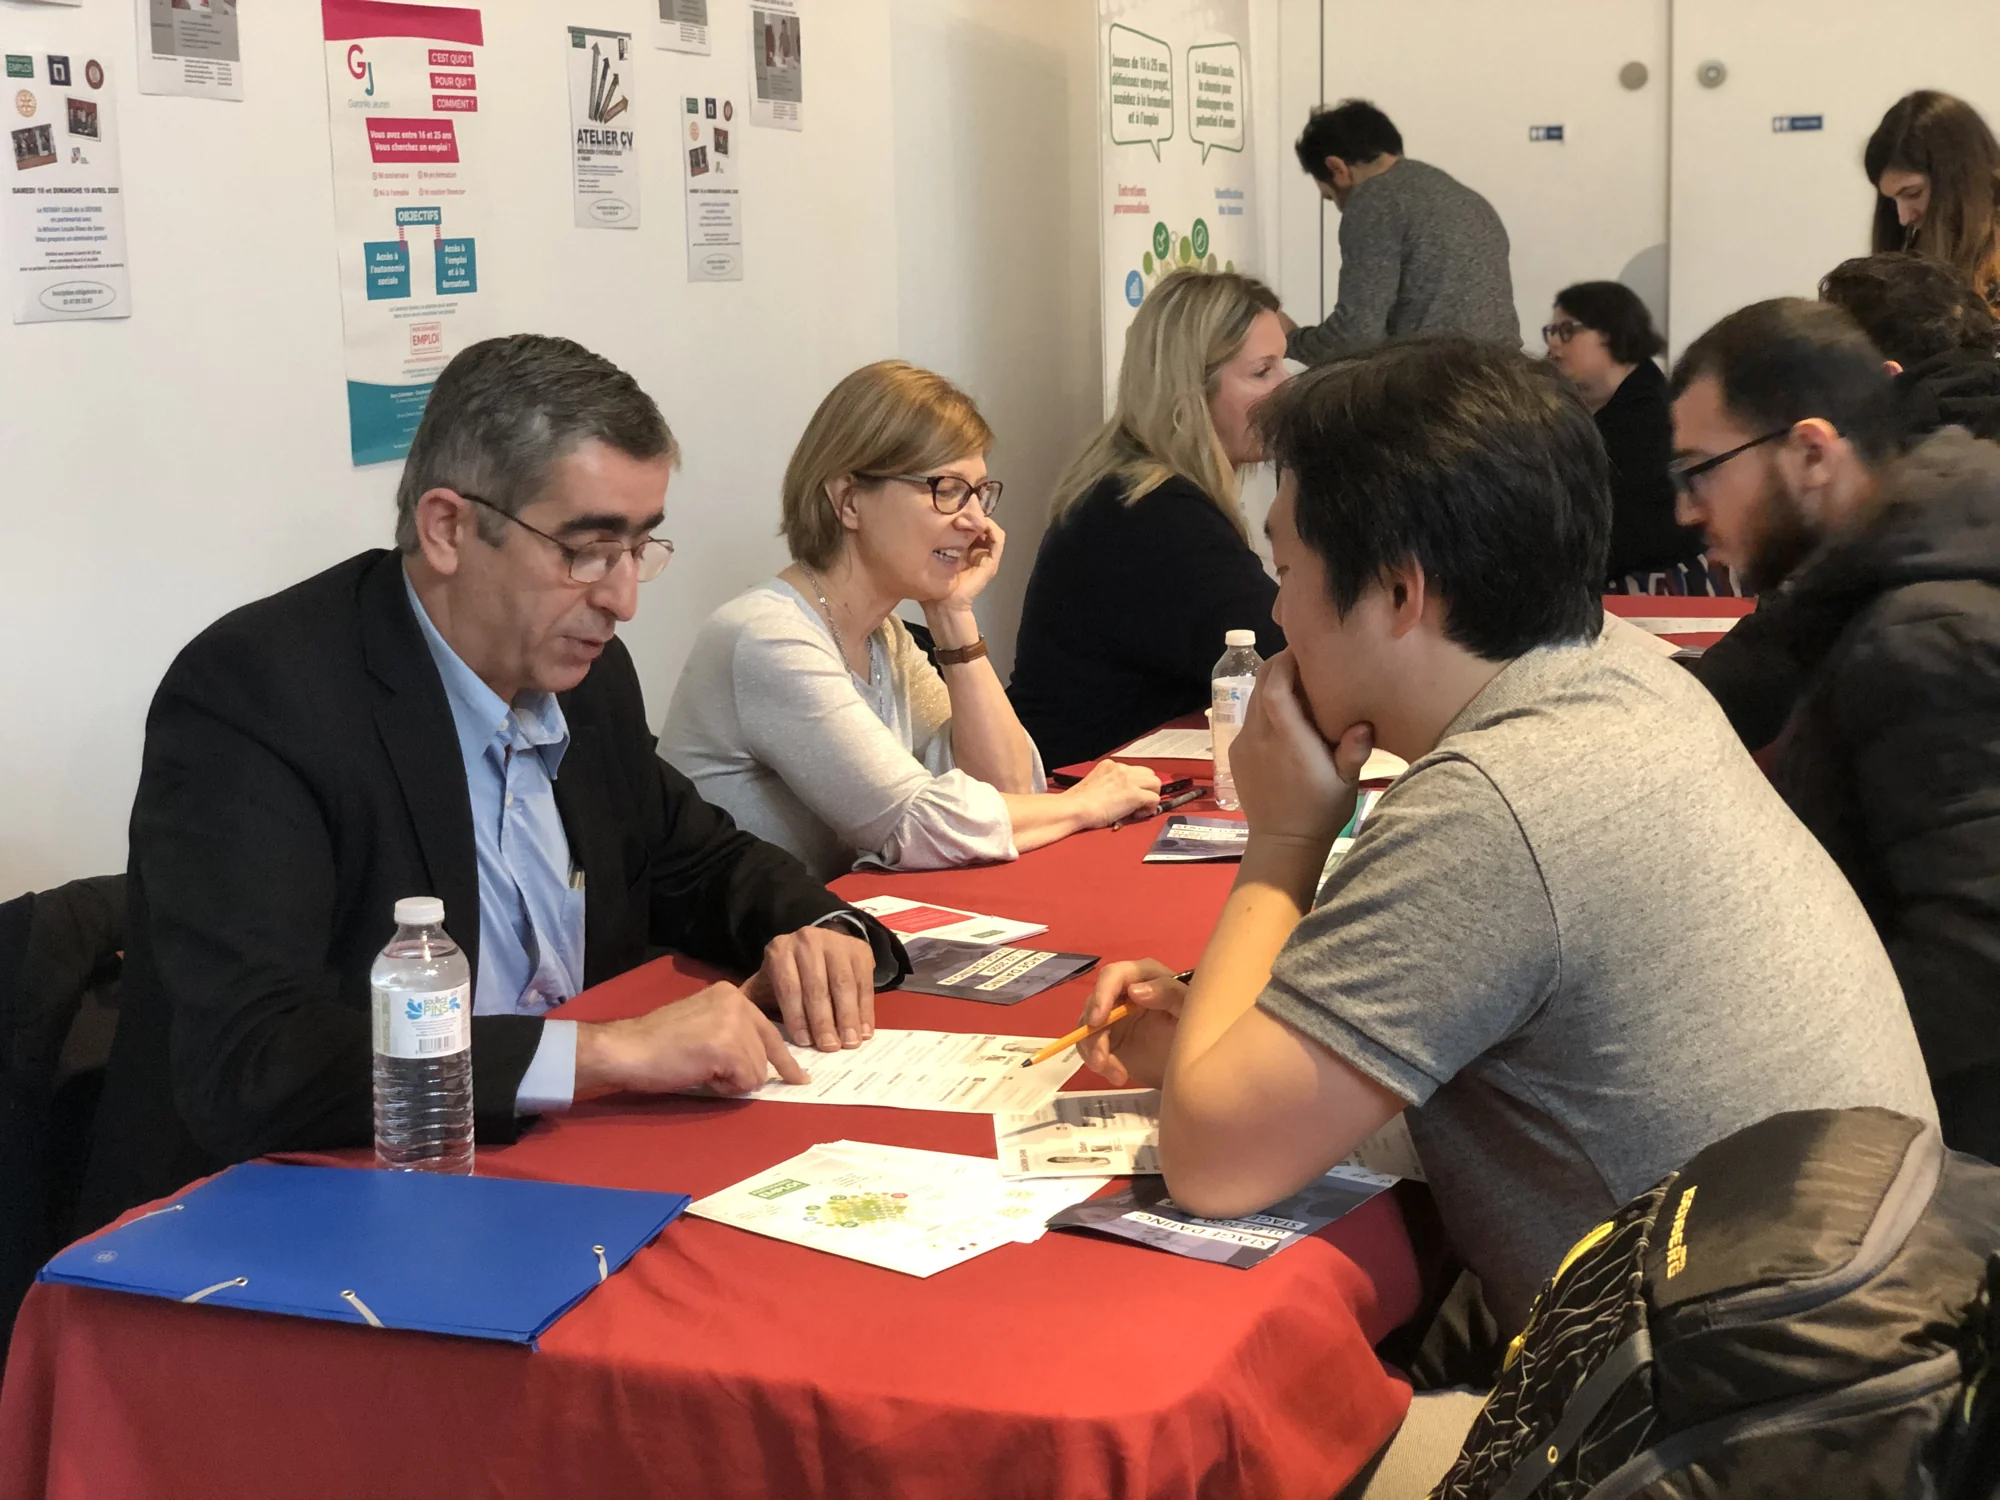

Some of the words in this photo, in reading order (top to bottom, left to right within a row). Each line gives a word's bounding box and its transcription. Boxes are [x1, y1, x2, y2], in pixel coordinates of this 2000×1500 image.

[431, 52, 449, 63] C'EST
[450, 53, 465, 65] QUOI
[435, 75, 454, 86] POUR
[455, 77, 467, 88] QUI
[437, 98, 470, 109] COMMENT
[370, 130, 385, 139] Vous
[577, 128, 618, 146] ATELIER
[620, 130, 634, 147] CV
[375, 143, 390, 151] Vous
[398, 210, 439, 222] OBJECTIFS
[444, 244, 460, 252] Accès
[376, 252, 393, 261] Accès
[412, 333, 440, 346] EMPLOI
[423, 1004, 449, 1016] PINS
[1134, 1213, 1207, 1235] DATING
[1210, 1230, 1267, 1247] STAGE
